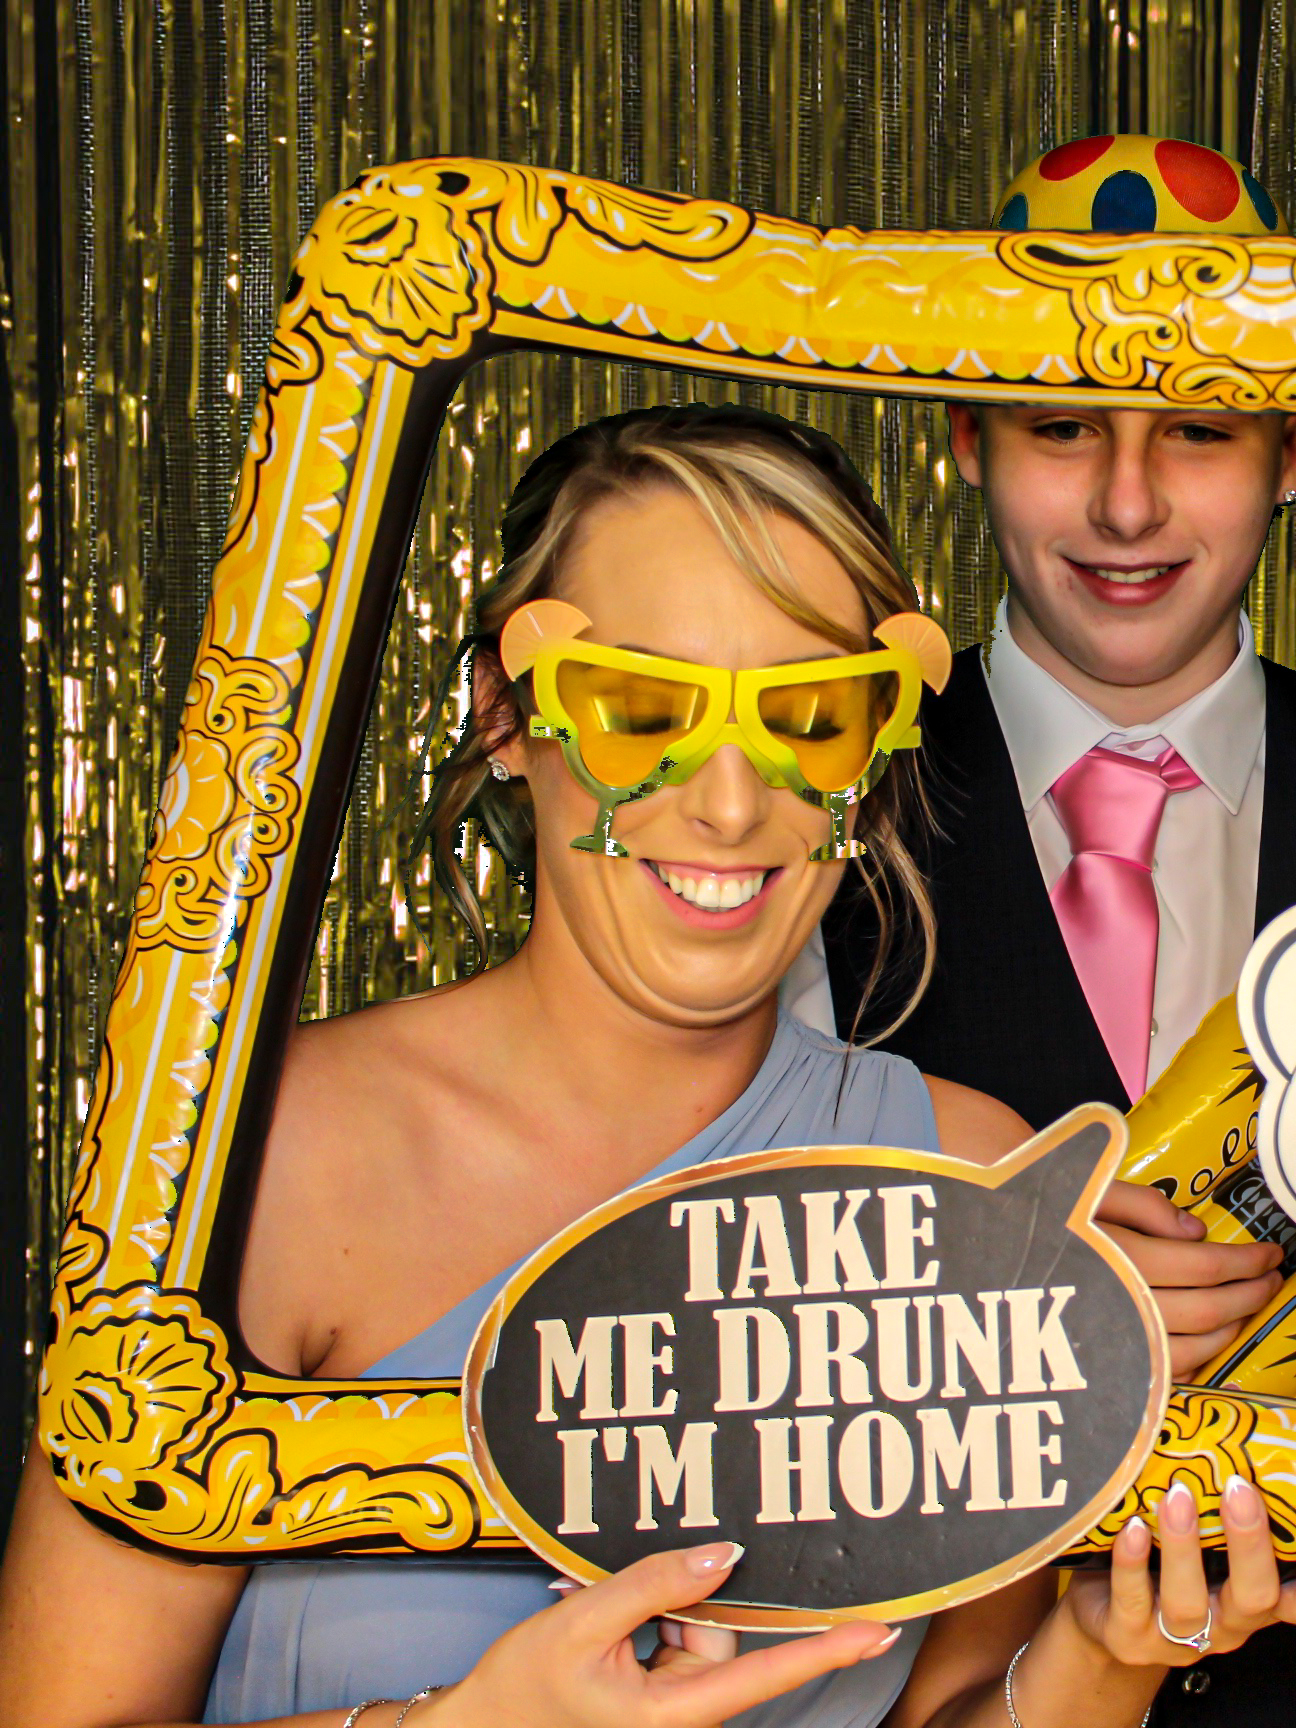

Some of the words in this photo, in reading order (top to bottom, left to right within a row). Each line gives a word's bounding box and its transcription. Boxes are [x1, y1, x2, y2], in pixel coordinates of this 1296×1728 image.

[670, 1184, 940, 1302] TAKE
[535, 1313, 679, 1422] ME
[713, 1286, 1087, 1412] DRUNK
[556, 1421, 718, 1534] I'M
[755, 1401, 1067, 1524] HOME
